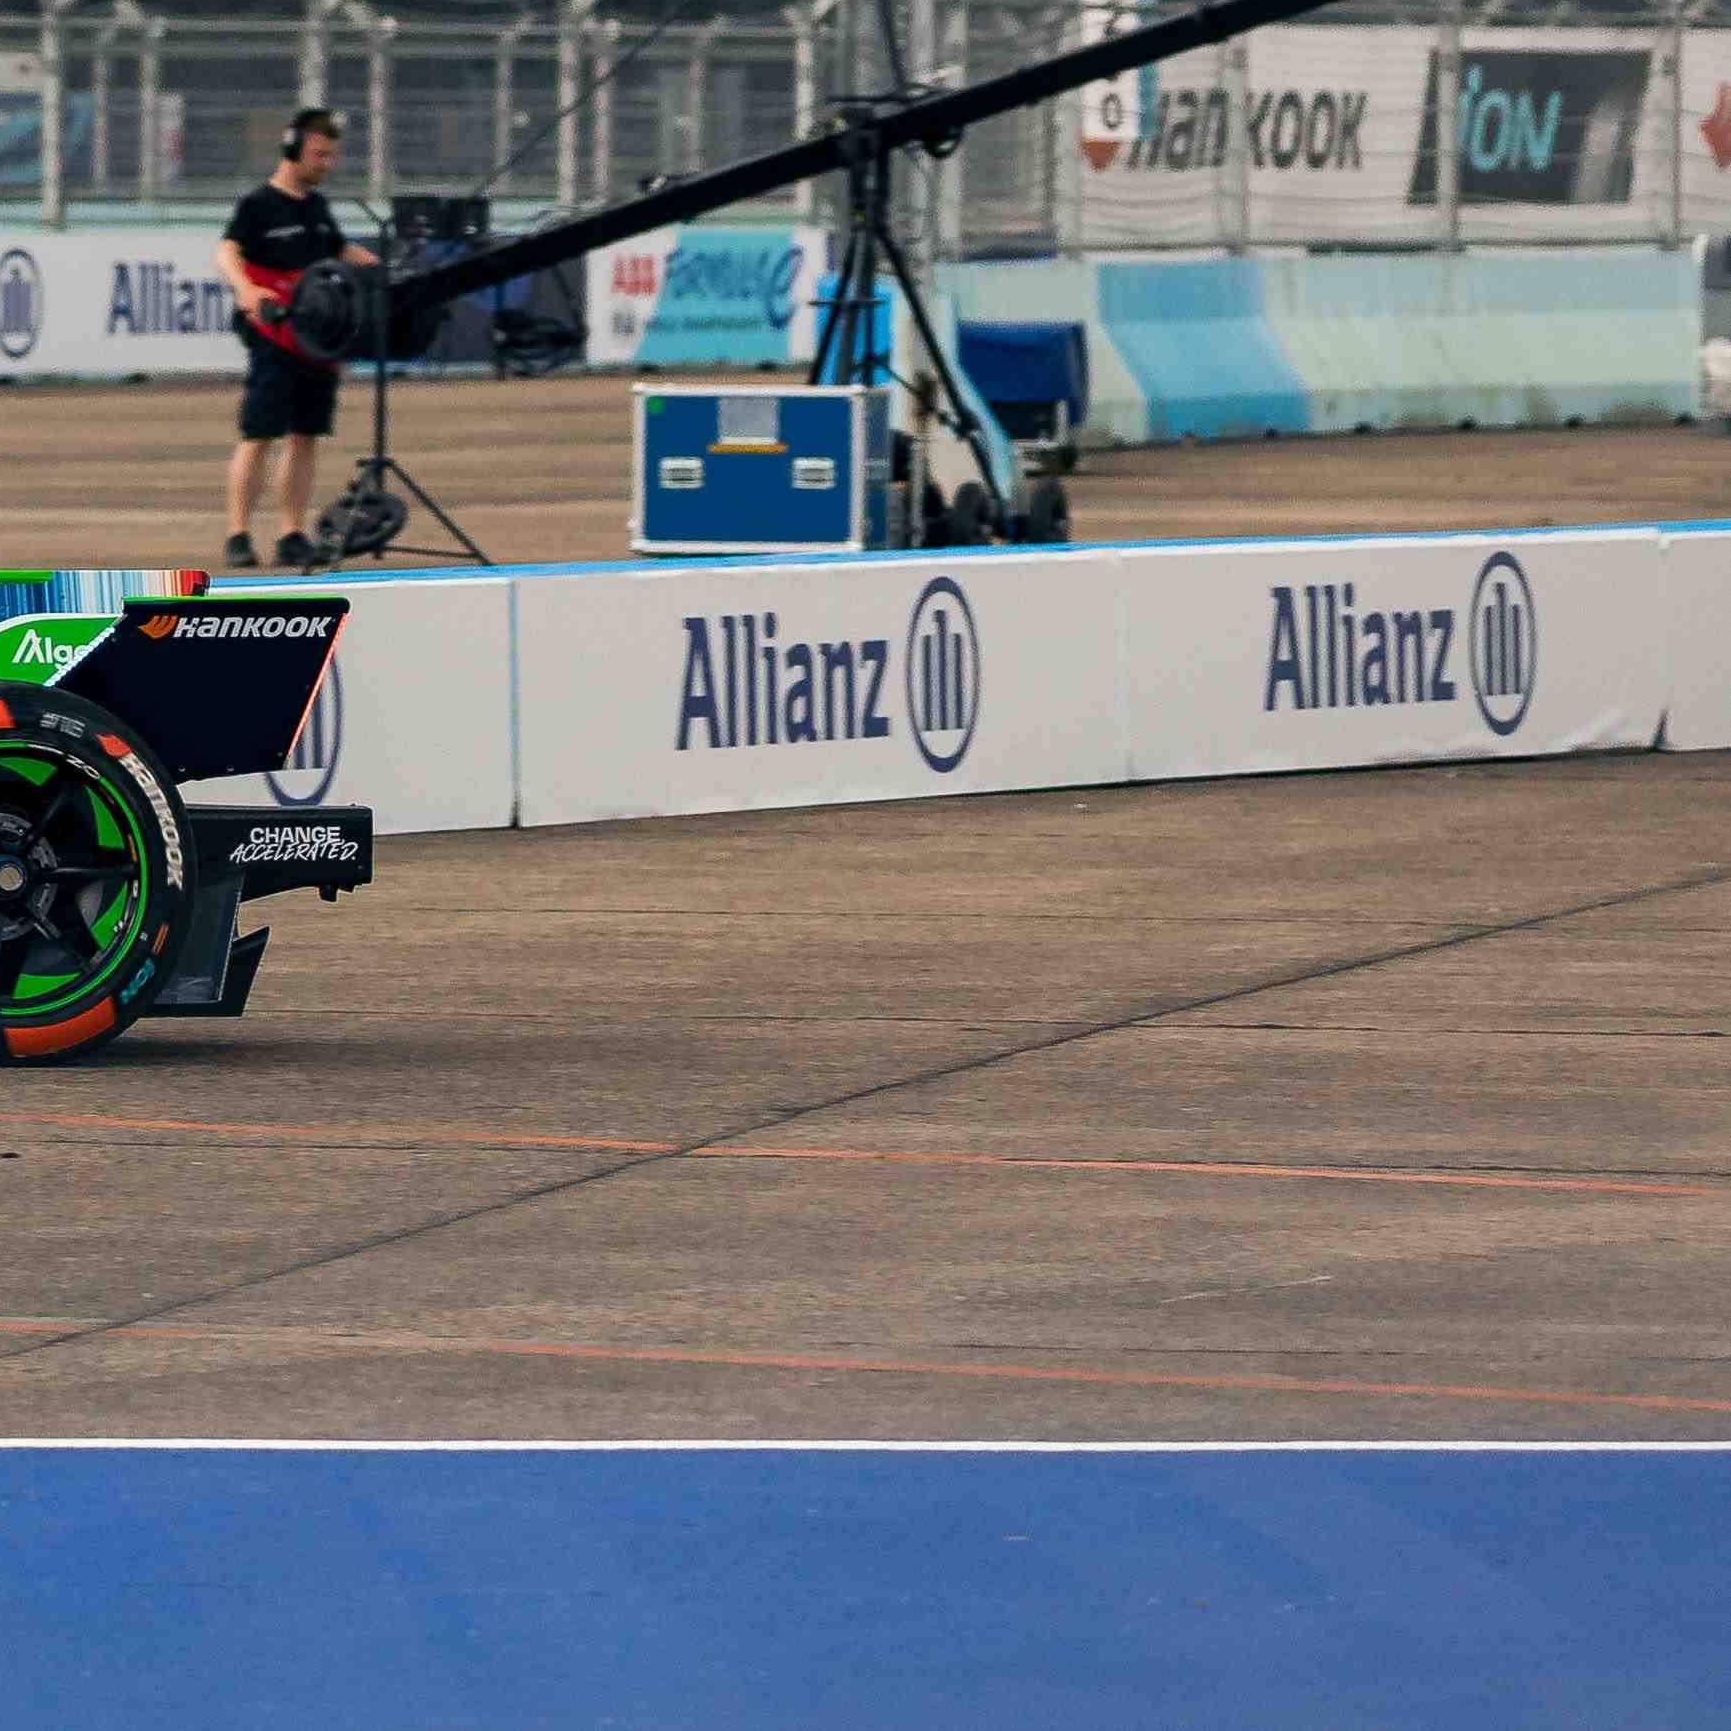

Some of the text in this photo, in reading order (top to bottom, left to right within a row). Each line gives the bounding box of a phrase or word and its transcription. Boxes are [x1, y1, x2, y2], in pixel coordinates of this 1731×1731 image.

[107, 262, 240, 336] Allianz
[674, 613, 890, 751] Allianz
[1265, 584, 1455, 712] Allianz
